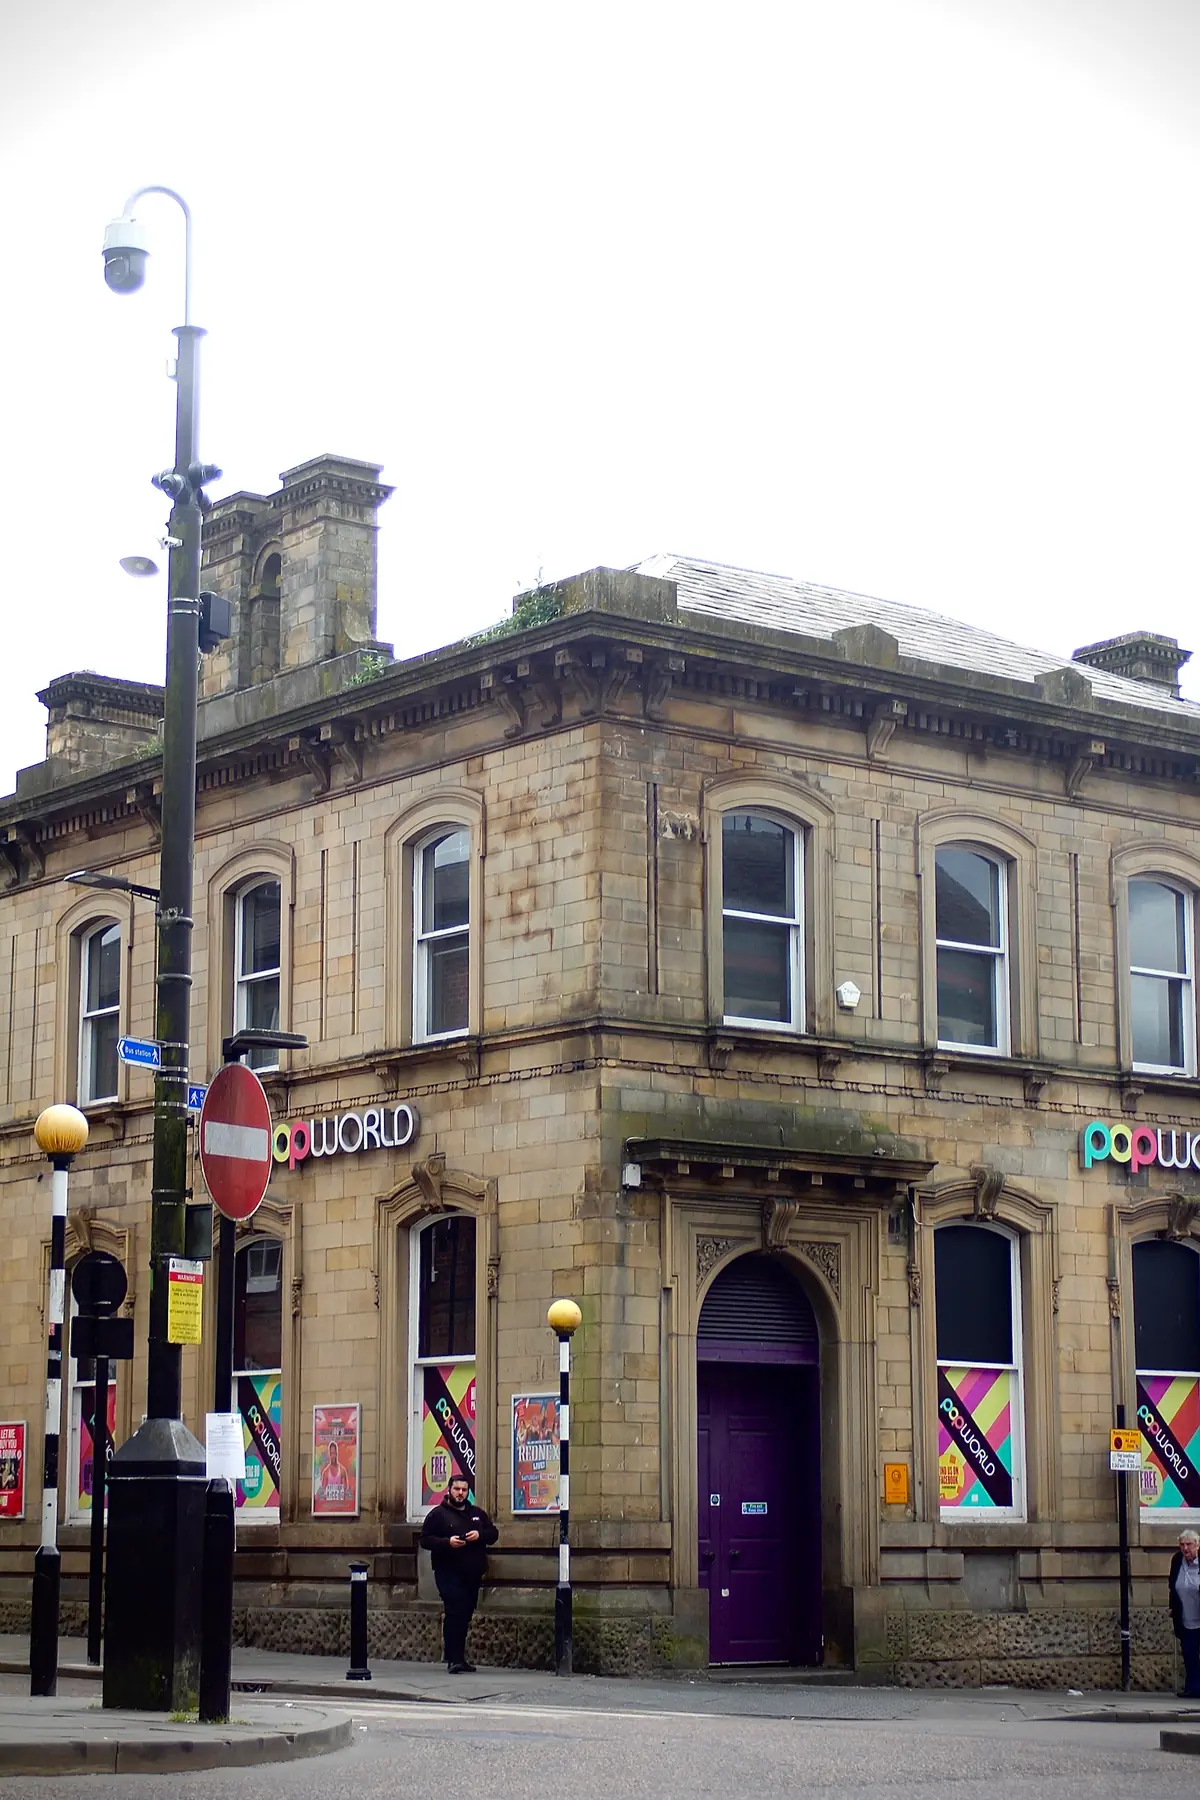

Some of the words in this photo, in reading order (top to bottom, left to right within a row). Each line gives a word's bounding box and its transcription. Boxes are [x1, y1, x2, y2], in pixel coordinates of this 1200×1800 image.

[125, 1046, 134, 1055] Bus
[135, 1049, 152, 1058] station
[272, 1104, 413, 1171] opWORLD
[940, 1397, 996, 1476] popWORLD
[1137, 1404, 1189, 1480] popWORLD
[431, 1456, 447, 1474] FREE
[1140, 1471, 1158, 1489] FREE
